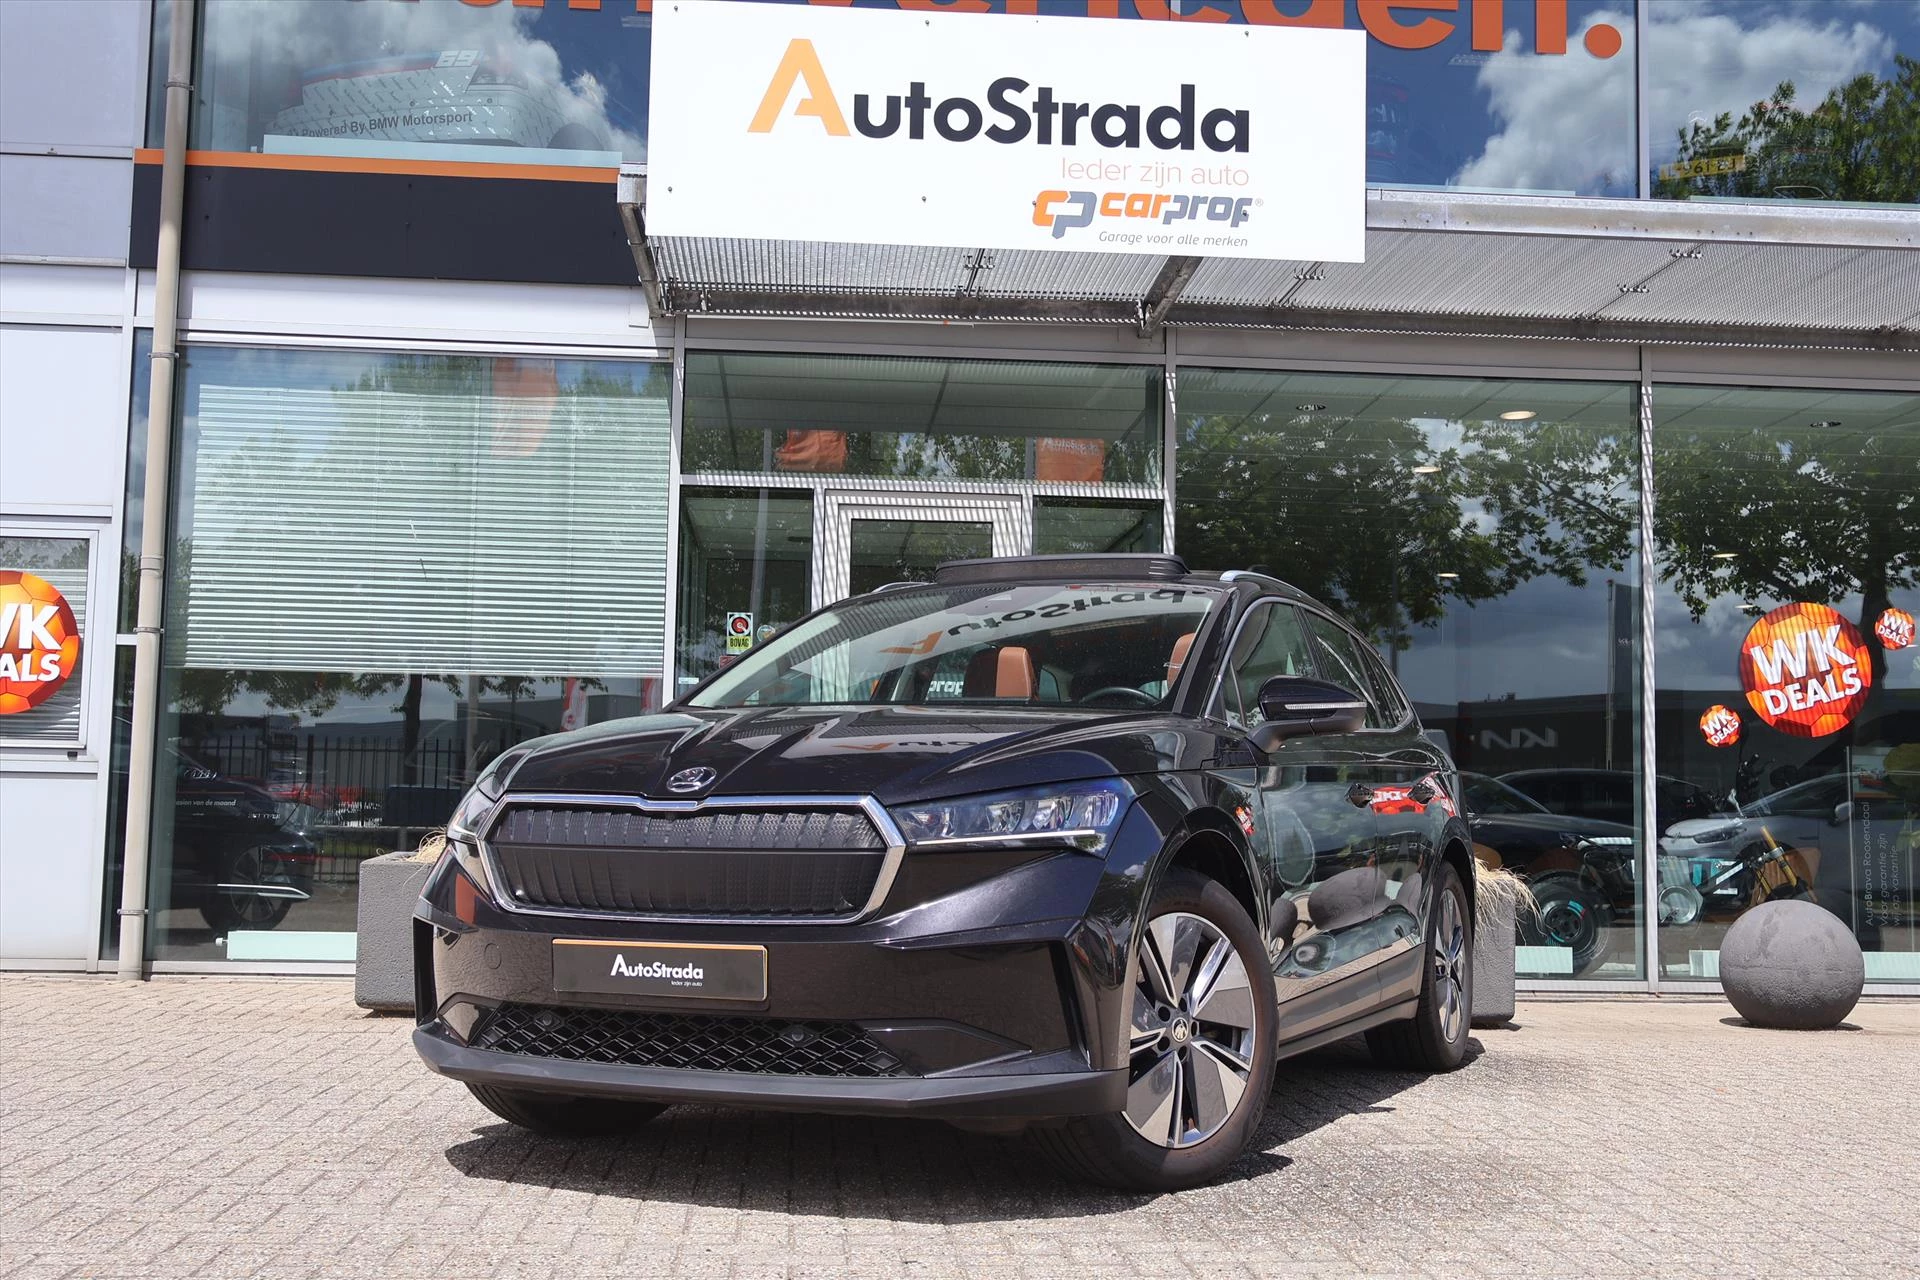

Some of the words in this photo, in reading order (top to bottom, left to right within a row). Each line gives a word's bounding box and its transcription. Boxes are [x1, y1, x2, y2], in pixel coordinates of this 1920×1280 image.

[747, 38, 1250, 153] AutoStrada
[303, 123, 348, 138] Powered
[350, 121, 365, 134] By
[369, 117, 400, 131] BMW
[402, 111, 473, 127] Motorsport
[1061, 158, 1132, 181] Ieder
[1140, 162, 1182, 188] zijn
[1191, 165, 1250, 186] auto
[1098, 231, 1142, 246] Garage
[1147, 234, 1173, 245] voor
[1177, 233, 1200, 245] alle
[1203, 235, 1248, 247] merken
[1877, 624, 1909, 647] DEALS
[1883, 612, 1914, 638] WK
[729, 637, 750, 648] BOVAG
[1750, 624, 1857, 686] WK
[0, 652, 61, 682] ALS
[1761, 667, 1863, 717] DEALS
[1702, 707, 1735, 736] WK
[1710, 717, 1740, 745] DEALS
[1862, 801, 1872, 866] Roosendaal
[610, 953, 704, 980] AutoStrada
